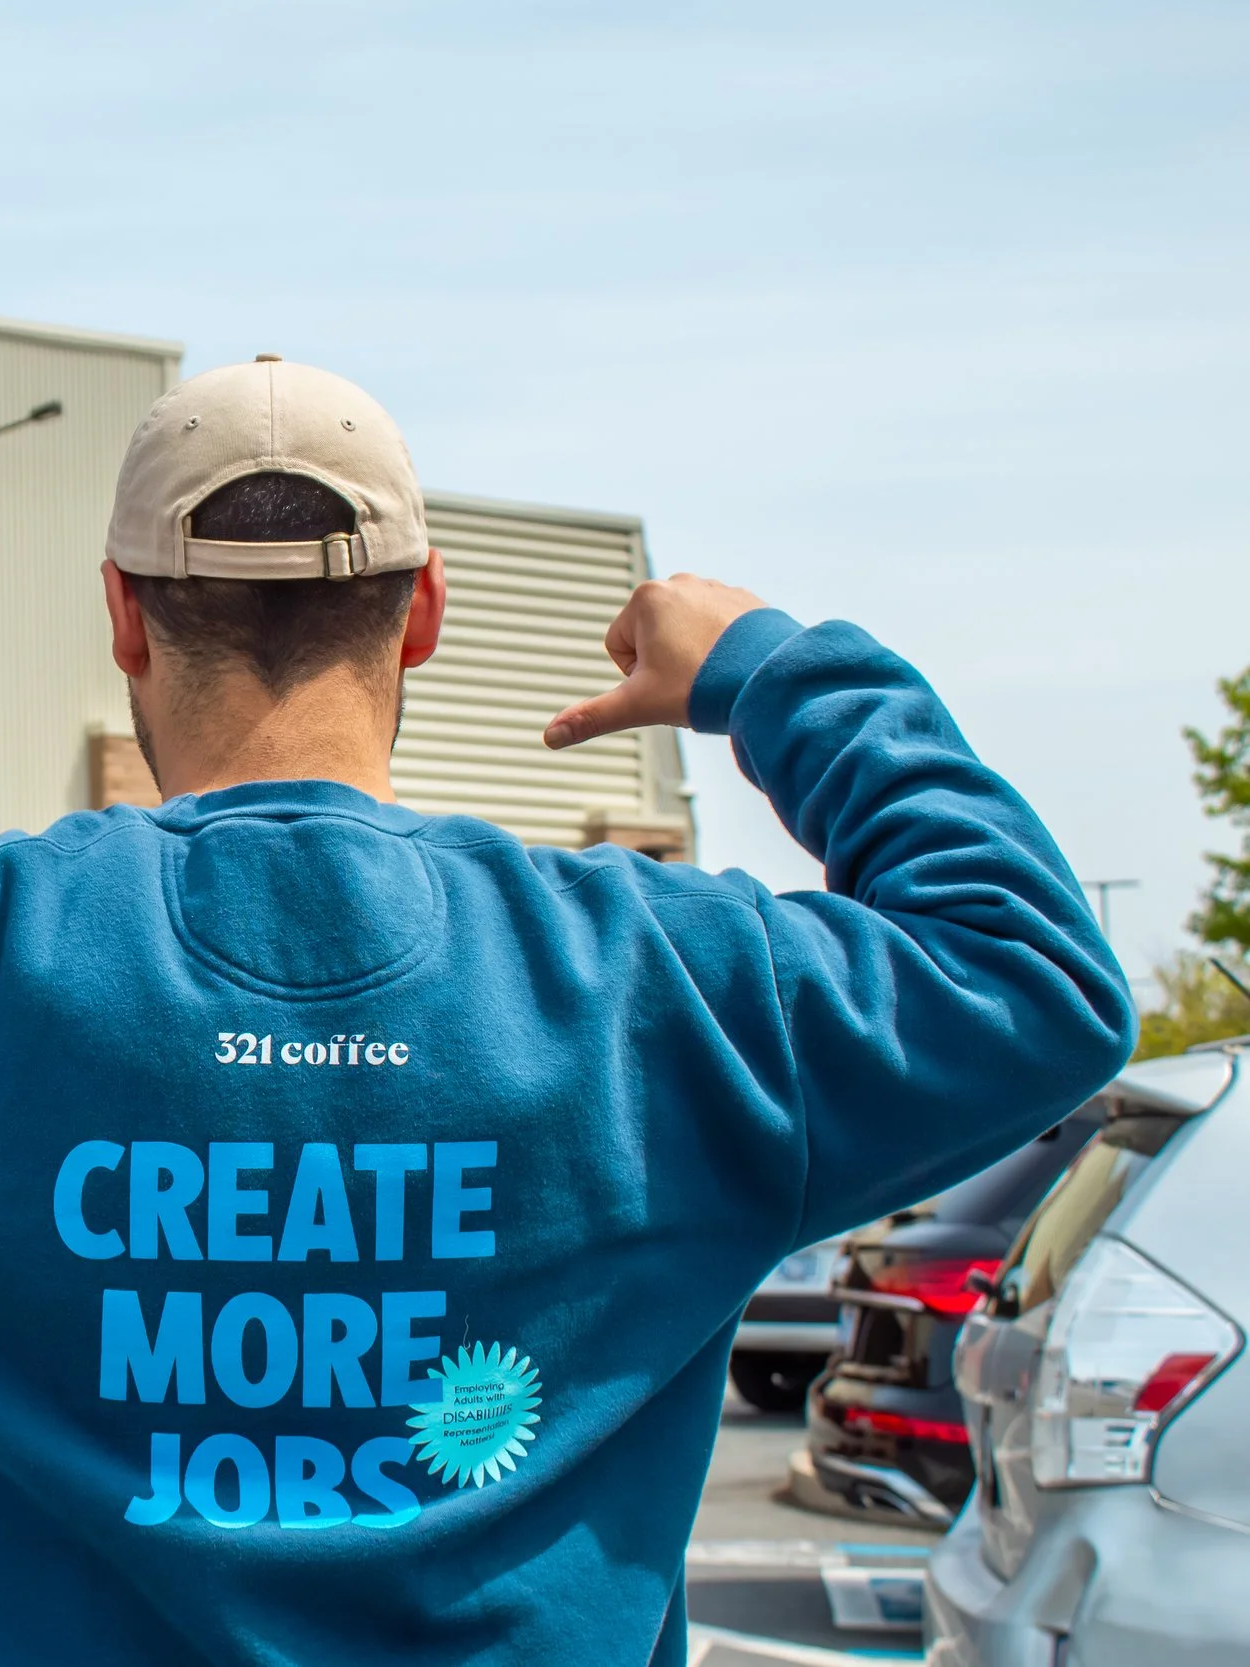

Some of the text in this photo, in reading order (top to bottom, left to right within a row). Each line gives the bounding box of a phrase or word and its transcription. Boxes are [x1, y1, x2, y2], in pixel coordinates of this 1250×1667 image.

[215, 1032, 409, 1066] 321 coffee
[53, 1140, 498, 1262] CREATE
[100, 1289, 447, 1408] MORE
[454, 1382, 505, 1394] Employing
[454, 1393, 505, 1405] Adults with
[443, 1403, 513, 1425] DISABILITIES
[443, 1419, 510, 1438] Representation
[124, 1433, 422, 1529] JOBS
